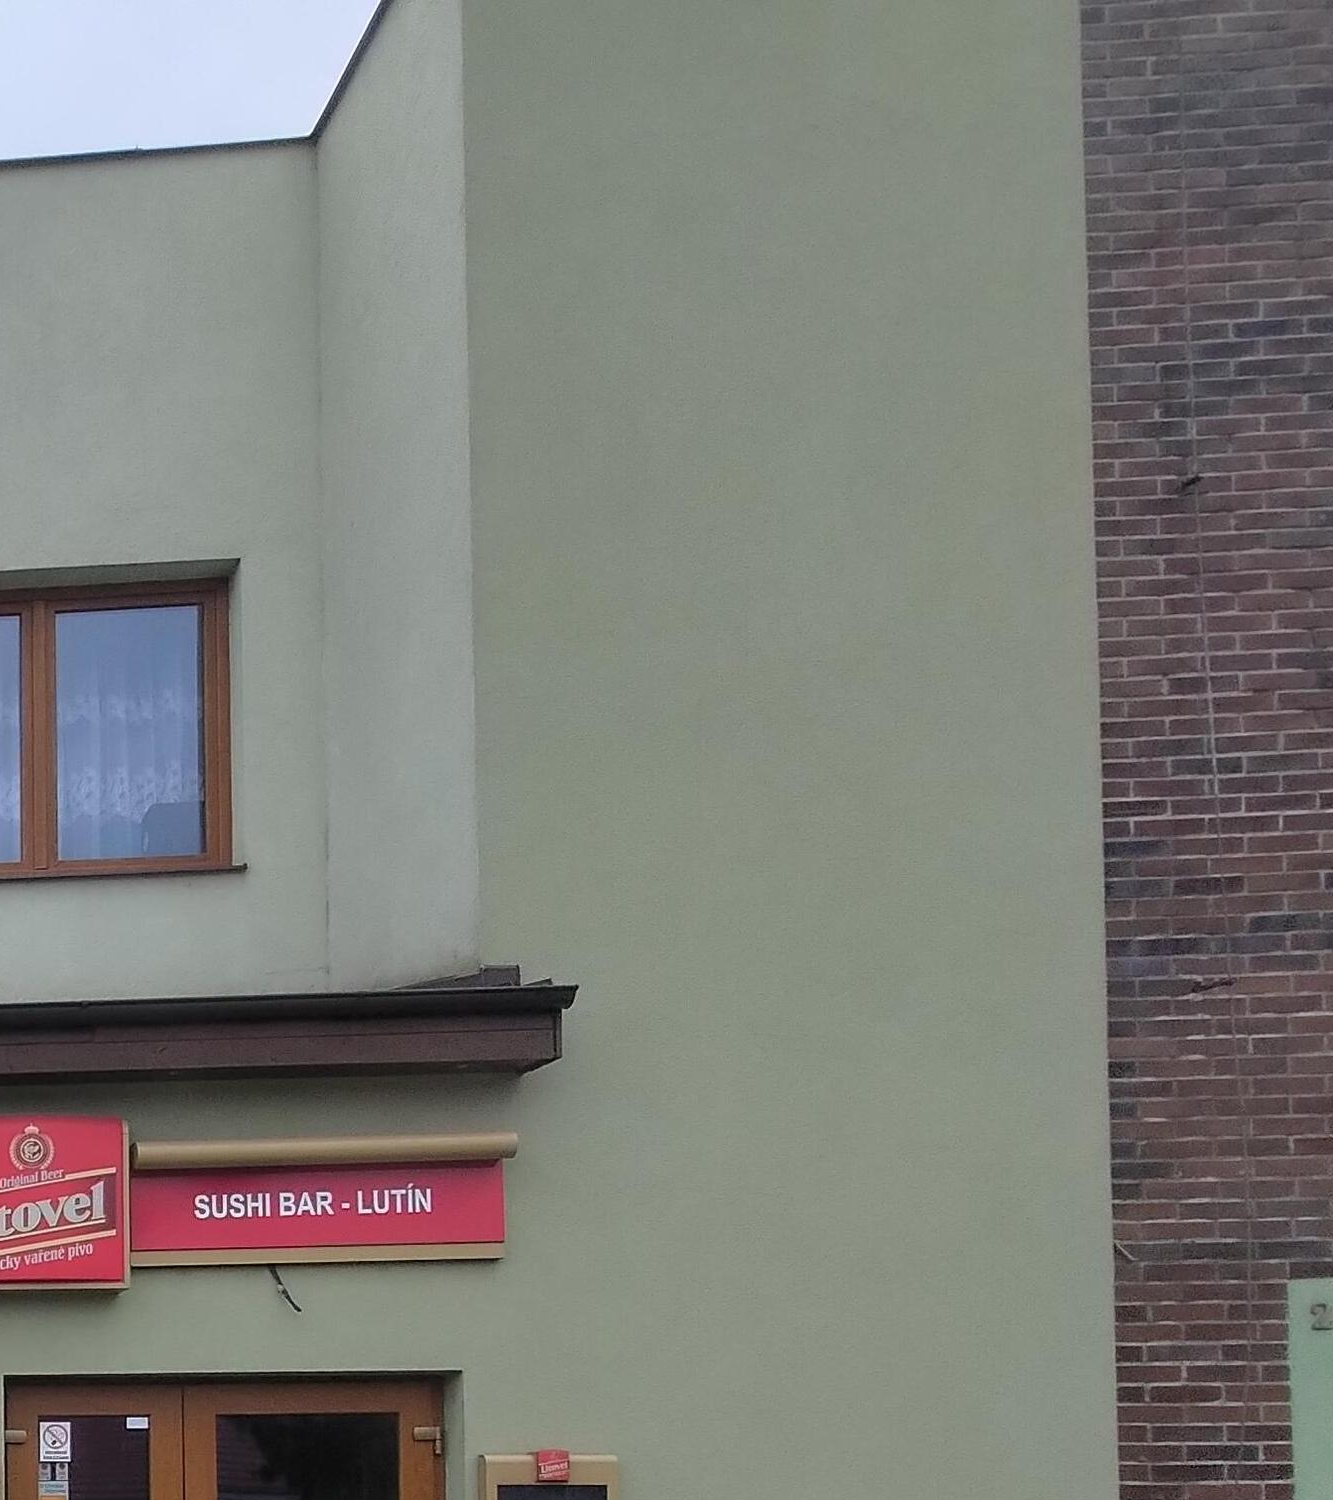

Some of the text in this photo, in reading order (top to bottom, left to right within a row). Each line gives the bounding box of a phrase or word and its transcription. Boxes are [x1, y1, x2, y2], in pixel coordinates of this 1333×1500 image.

[0, 1169, 64, 1189] Original Beer
[194, 1193, 271, 1219] SUSHI
[279, 1191, 334, 1216] BAR
[357, 1183, 432, 1215] LUTÍN
[67, 1243, 93, 1261] pivo
